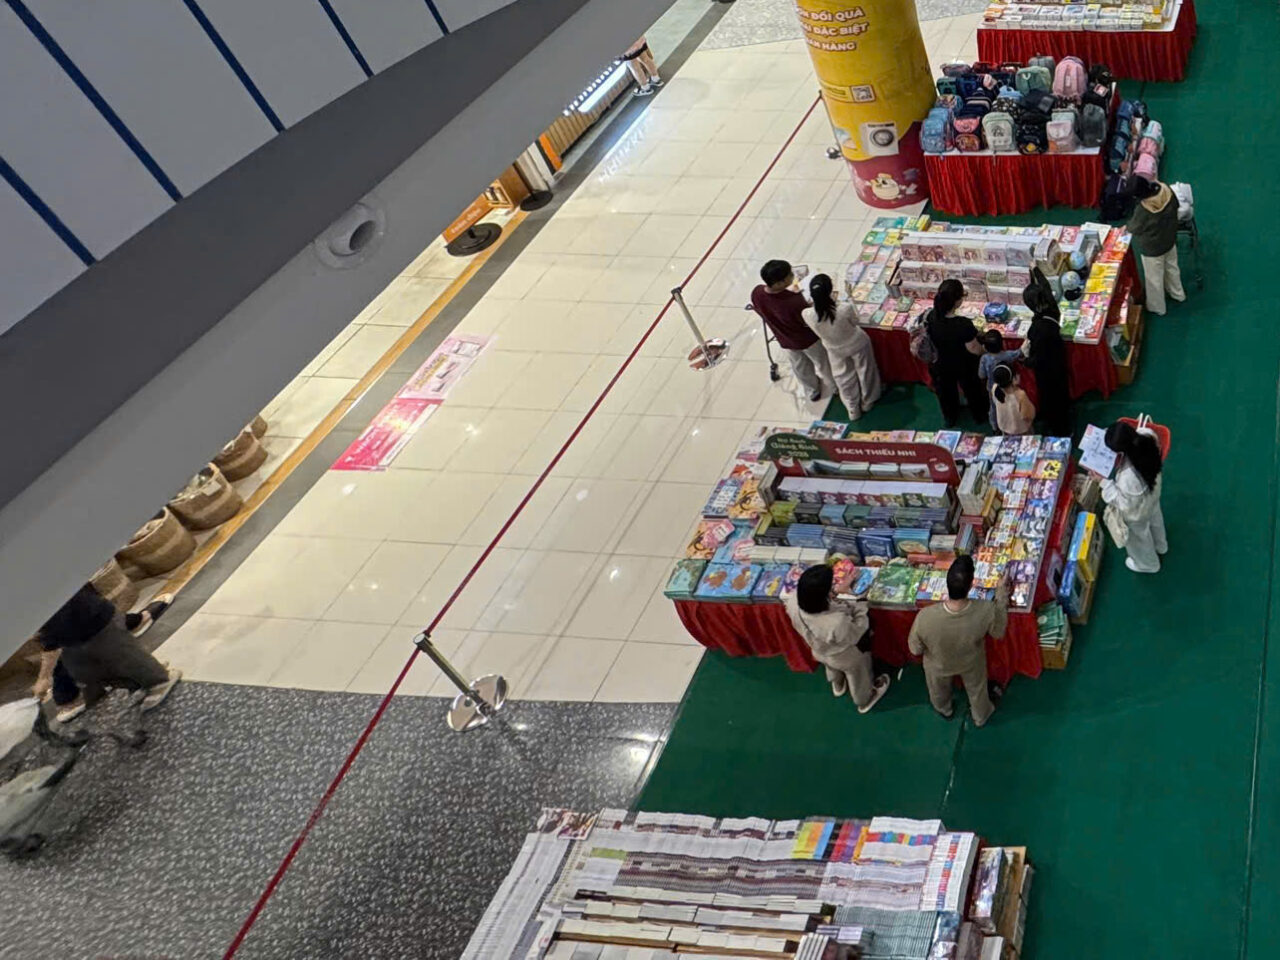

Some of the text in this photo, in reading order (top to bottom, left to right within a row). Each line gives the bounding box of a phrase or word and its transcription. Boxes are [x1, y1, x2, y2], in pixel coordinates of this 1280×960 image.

[834, 446, 917, 457] SÁCH THIẾU NHI
